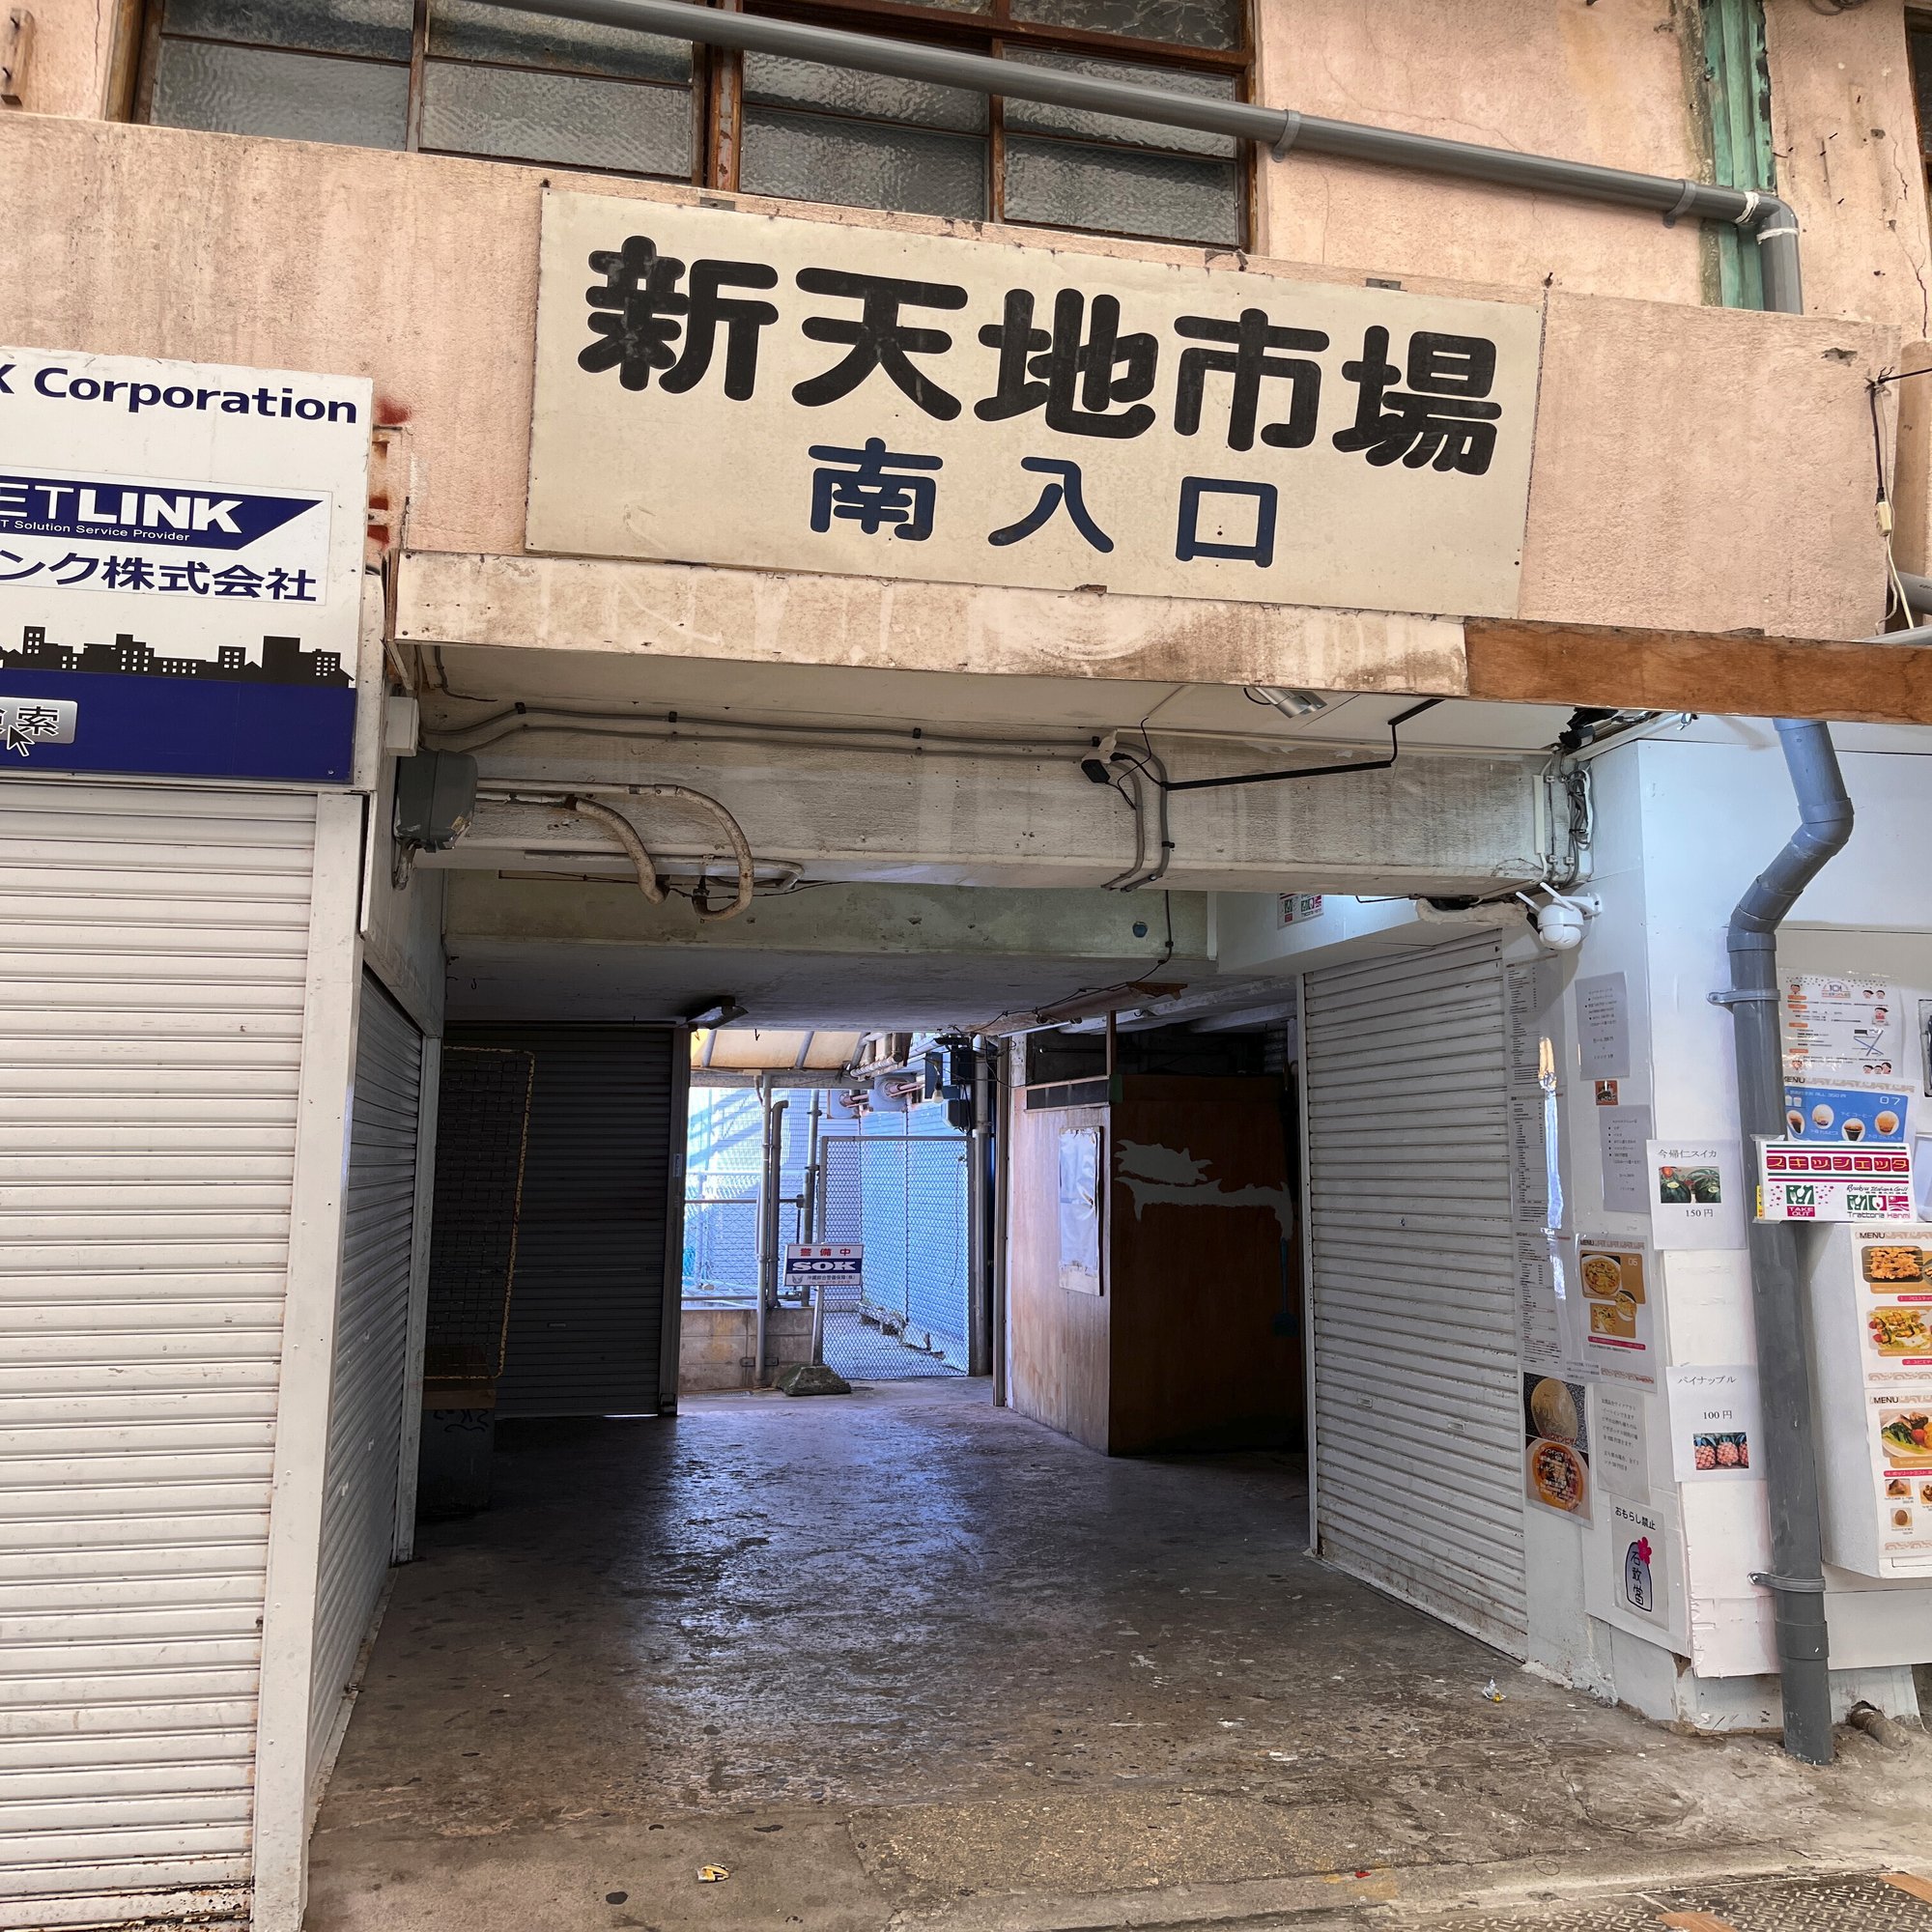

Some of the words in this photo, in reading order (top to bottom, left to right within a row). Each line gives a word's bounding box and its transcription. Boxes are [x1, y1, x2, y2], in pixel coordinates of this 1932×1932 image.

[578, 235, 1501, 474] 新天地市場
[34, 367, 357, 423] Corporation
[809, 437, 1278, 567] 南入口
[14, 521, 71, 532] Solution
[75, 525, 128, 537] Service
[133, 529, 190, 541] Provider
[0, 550, 316, 602] ンク株式会社
[1880, 1096, 1900, 1105] 07
[1659, 1150, 1717, 1158] 今帰仁スイカ
[793, 1262, 856, 1270] SOK
[1678, 1376, 1737, 1385] パイナップル
[1615, 1507, 1656, 1530] おもらし禁止
